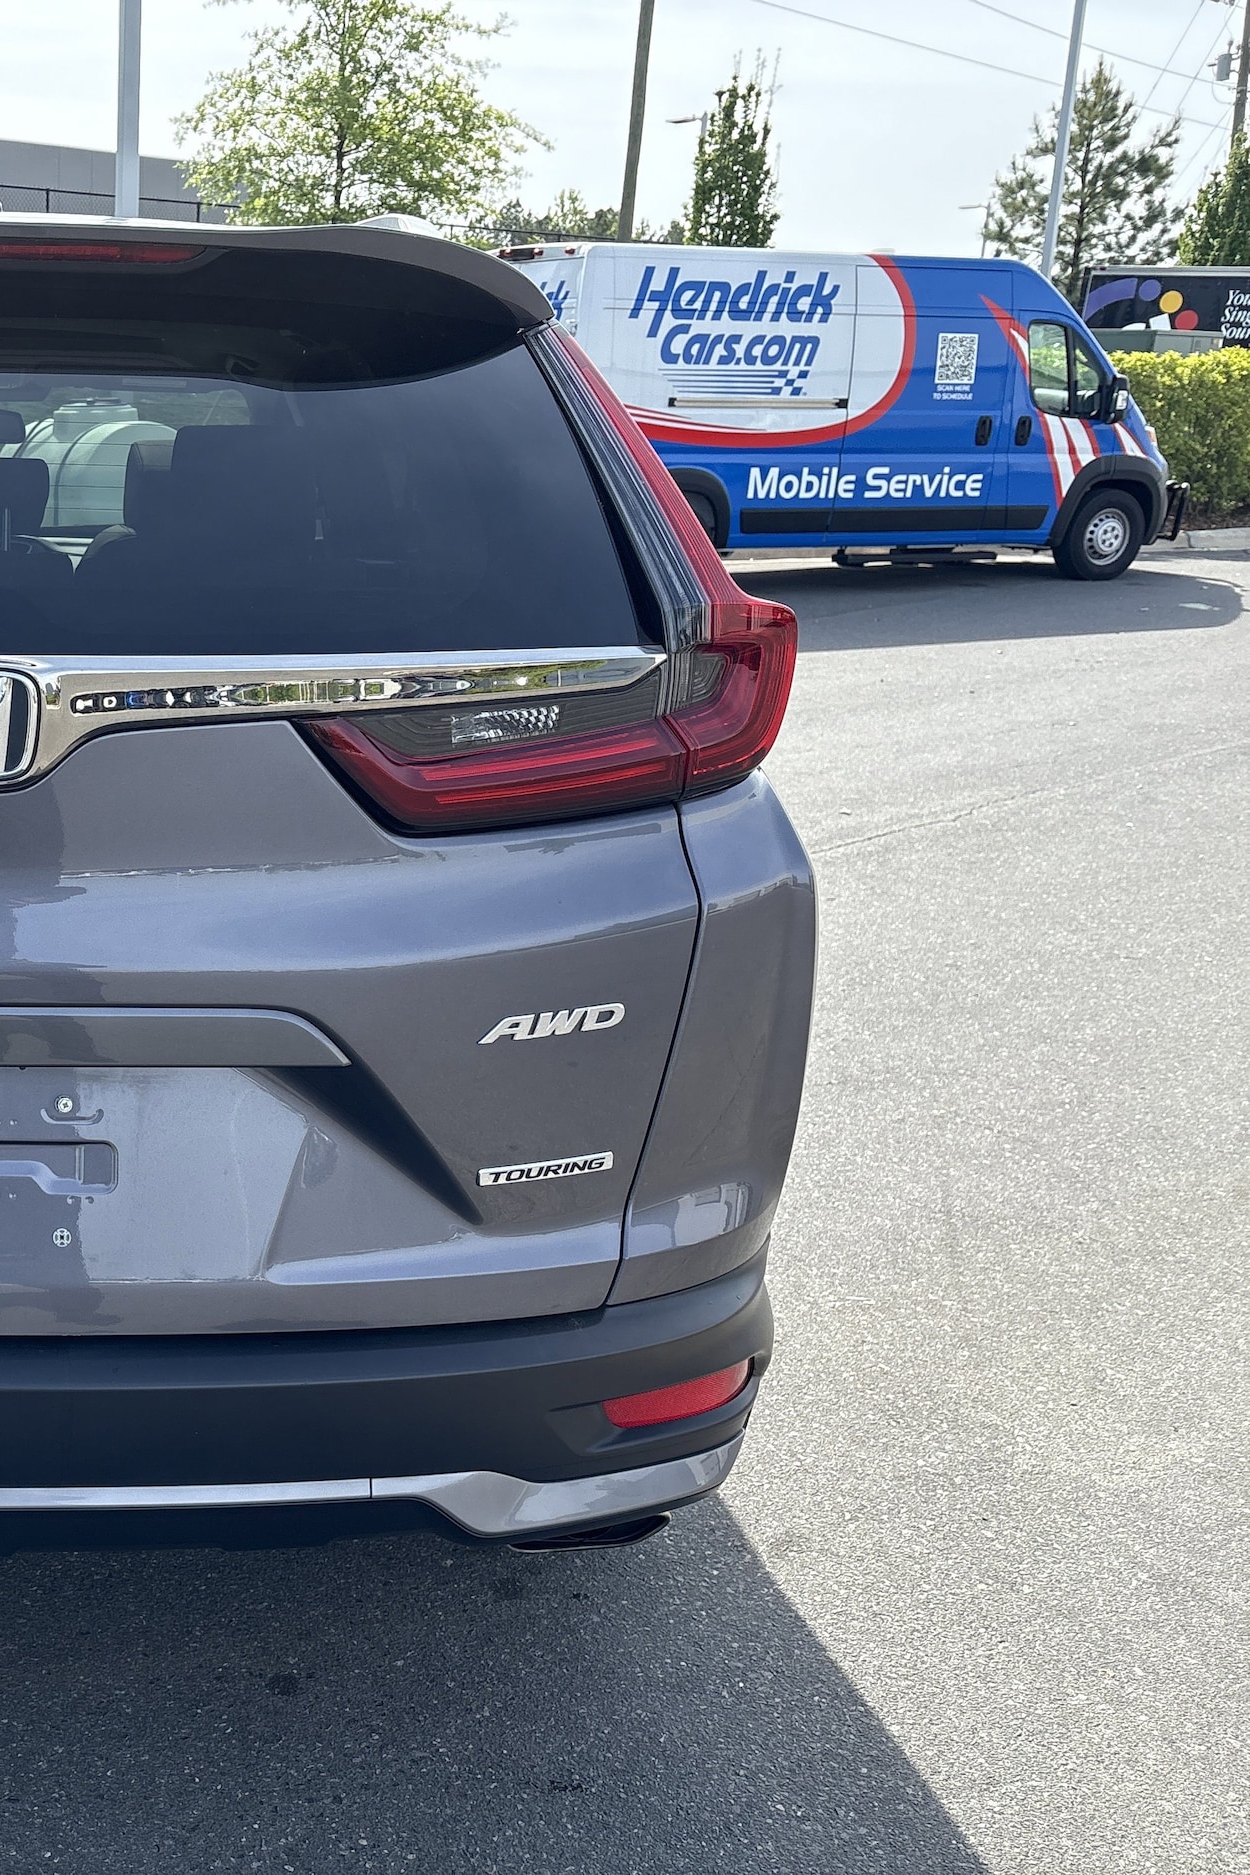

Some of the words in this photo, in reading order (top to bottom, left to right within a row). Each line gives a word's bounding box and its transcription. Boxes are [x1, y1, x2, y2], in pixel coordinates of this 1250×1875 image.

[628, 265, 840, 338] Hendrick
[660, 323, 820, 366] Cars.com
[747, 466, 856, 499] Mobile
[864, 466, 984, 498] Service
[477, 1002, 626, 1045] AWD
[489, 1157, 606, 1183] TOURING
